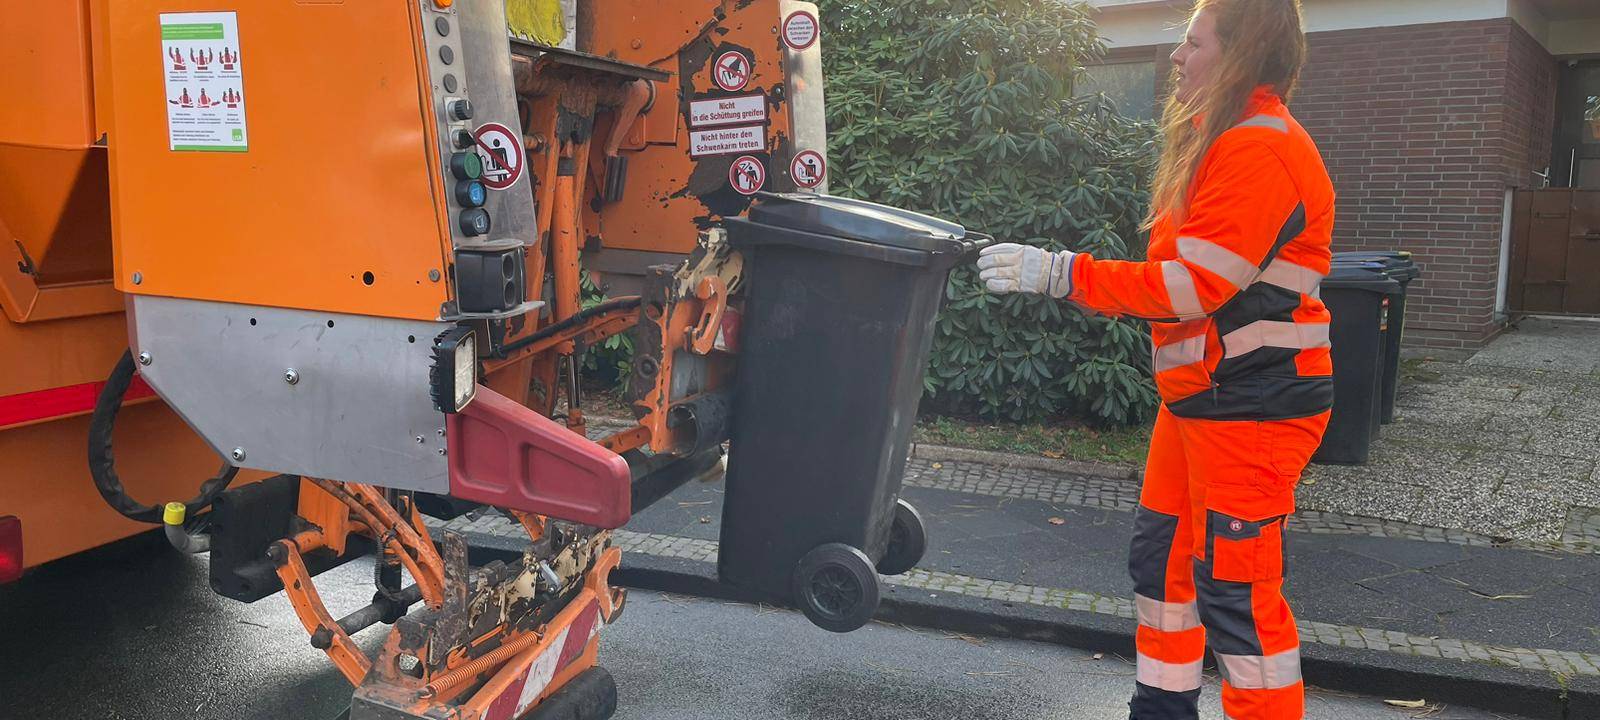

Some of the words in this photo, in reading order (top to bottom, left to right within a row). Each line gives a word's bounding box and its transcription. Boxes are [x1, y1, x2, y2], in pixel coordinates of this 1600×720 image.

[718, 102, 736, 110] Nicht
[710, 111, 740, 120] Schüttung
[742, 108, 764, 118] greifen
[696, 142, 737, 152] Schwenkarm
[738, 140, 758, 148] treten
